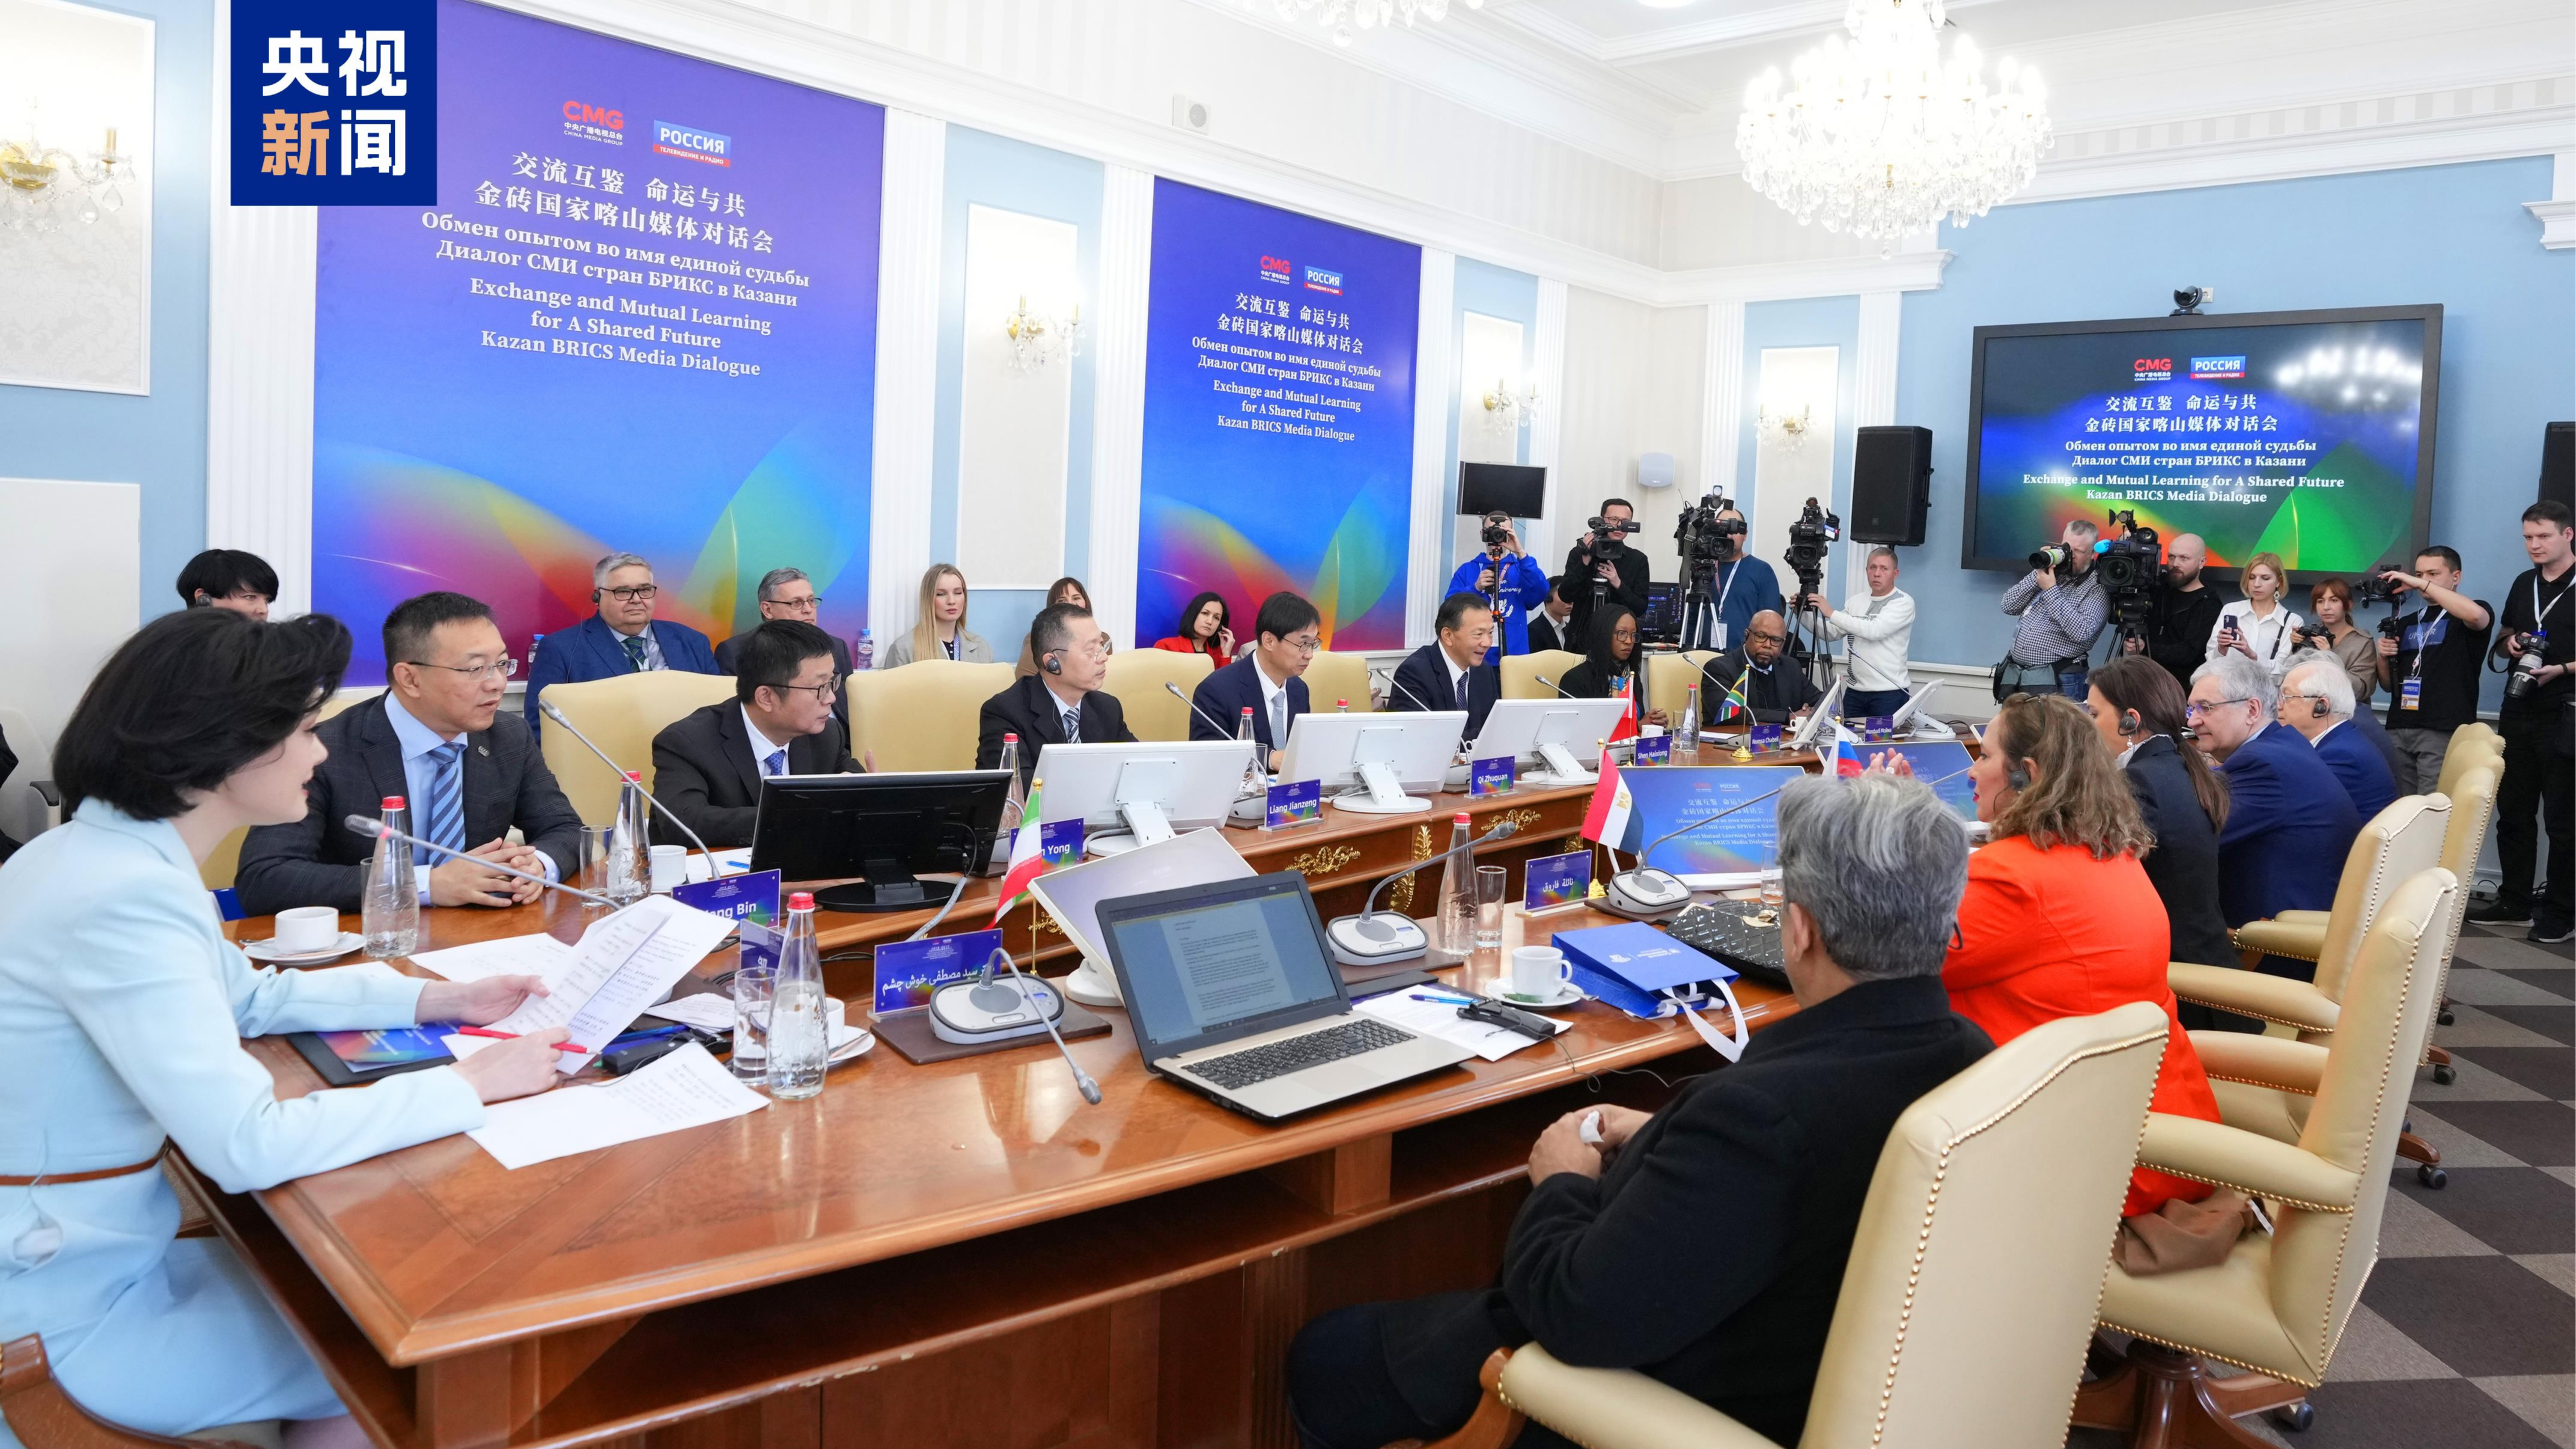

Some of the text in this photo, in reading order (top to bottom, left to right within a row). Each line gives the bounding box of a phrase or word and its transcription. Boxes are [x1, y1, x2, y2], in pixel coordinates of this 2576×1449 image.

[563, 100, 624, 130] CMG
[564, 121, 623, 141] 中央广播电视总台
[660, 127, 725, 154] РОССИЯ
[660, 146, 699, 159] ТЕЛЕВИДЕНИЕ
[705, 156, 723, 165] РАДИО
[512, 151, 745, 217] 交流互鉴 命运与共
[474, 180, 773, 254] 金砖国家喀山媒体对话会
[422, 212, 809, 287] Обмен опытом во имя единой судьбы
[436, 240, 797, 307] Диалог СМИ стран БРИКС в Казани
[1260, 255, 1291, 274] CMG
[1308, 270, 1340, 287] РОССИЯ
[470, 278, 772, 335] Exchange and Mutual Learning
[1235, 293, 1350, 330] 交流互鉴 命运与共
[531, 310, 721, 348] for A Shared Future
[1217, 313, 1363, 355] 金砖国家喀山媒体对话会
[481, 330, 761, 377] Kazan BRICS Media Dialogue
[1192, 336, 1381, 377] Обмен опытом во имя единой судьбы
[1198, 355, 1375, 392] Диалог СМИ стран БРИКС в Казани
[2134, 358, 2171, 371] CMG
[2195, 360, 2240, 371] РОССИЯ
[1213, 380, 1361, 412] Exchange and Mutual Learning
[2106, 394, 2257, 413] 交流互鉴 命运与共
[1241, 400, 1335, 423] for A Shared Future
[1217, 415, 1355, 442] Kazan BRICS Media Dialogue
[2084, 416, 2278, 433] 金砖国家喀山媒体对话会
[2065, 440, 2316, 454] Обмен опытом во имя единой судьбы
[2072, 455, 2307, 468] Диалог СМИ стран БРИКС в Казани
[2023, 474, 2344, 489] Exchange and Mutual Learning for A Shared Future
[2086, 489, 2267, 504] Kazan BRICS Media Dialogue
[1478, 774, 1508, 784] Qi Zhuquan
[1270, 799, 1317, 814] Liang Jianzeng
[1047, 844, 1070, 855] Yong
[1542, 880, 1559, 892] فاروق
[737, 901, 757, 915] Bin
